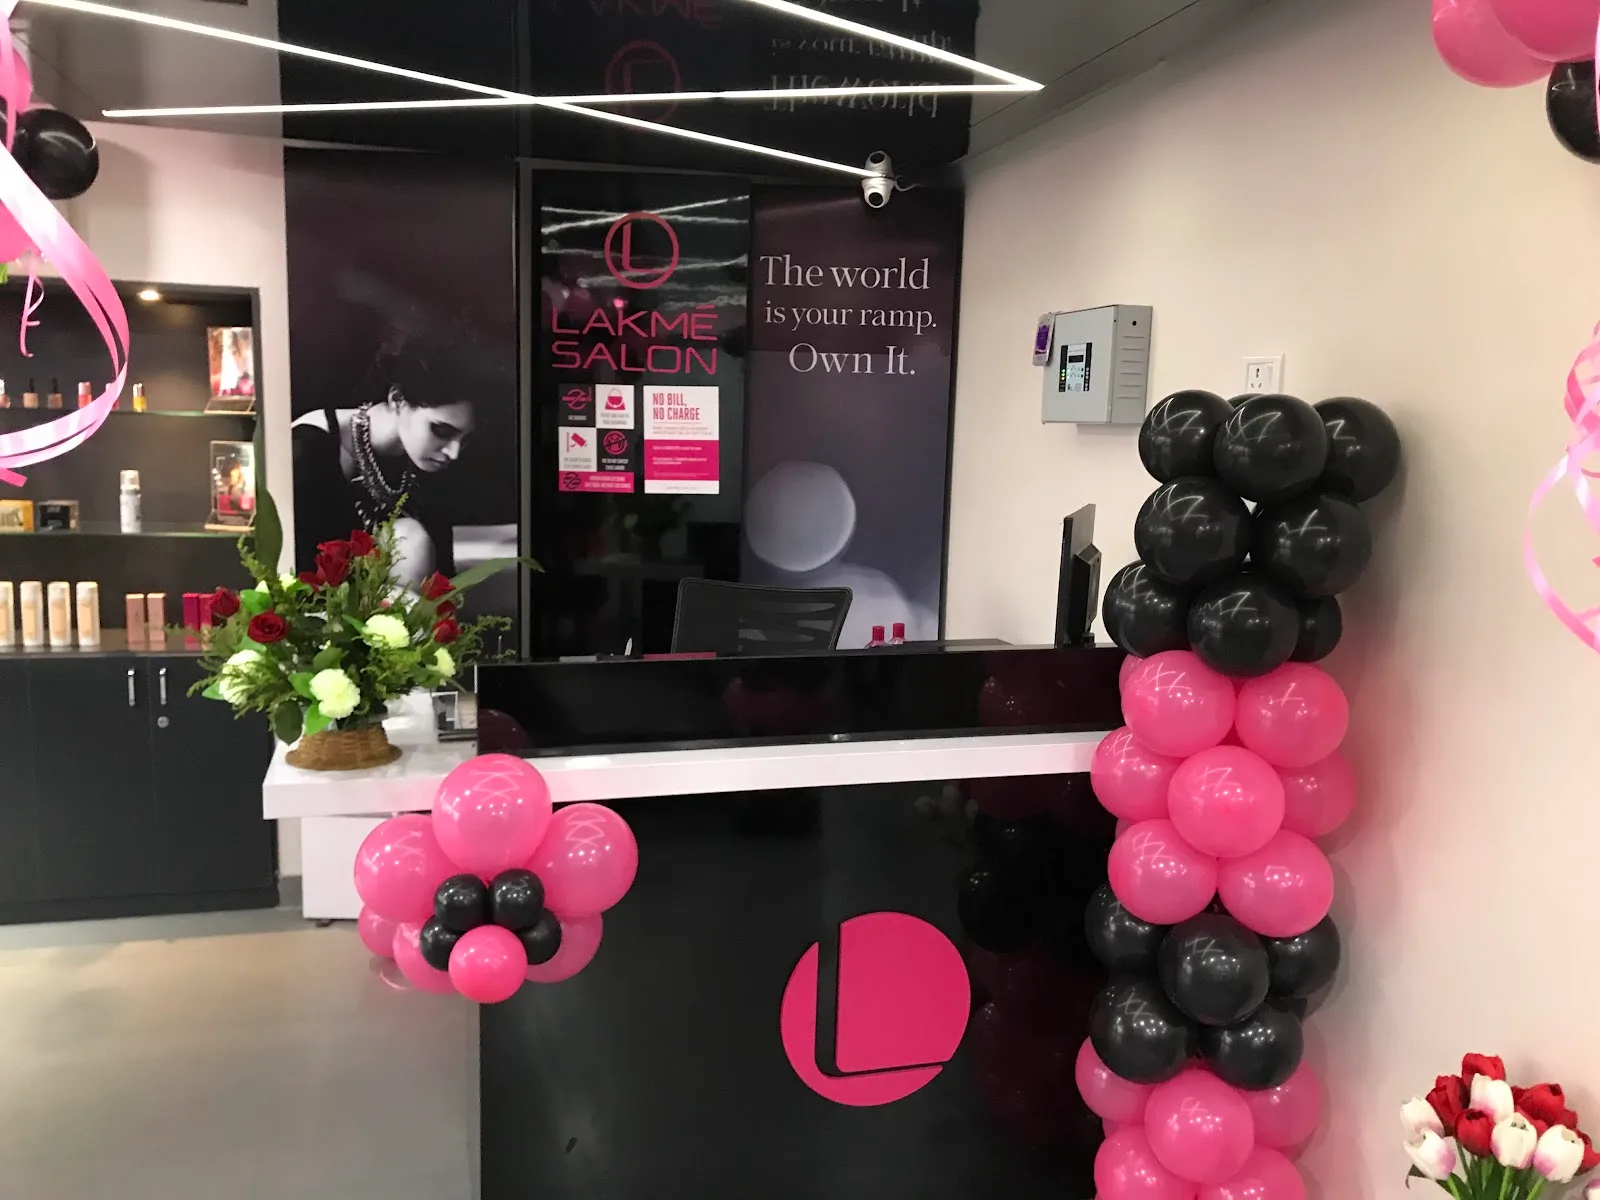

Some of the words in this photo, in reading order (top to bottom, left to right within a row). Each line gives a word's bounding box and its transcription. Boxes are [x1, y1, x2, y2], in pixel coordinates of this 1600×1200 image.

[759, 254, 824, 287] The
[829, 257, 931, 290] world
[551, 304, 719, 341] LAKMÉ
[764, 300, 786, 324] is
[791, 306, 853, 332] your
[858, 308, 938, 336] ramp.
[551, 340, 718, 375] SALON
[788, 342, 875, 374] Own
[884, 345, 916, 376] It.
[652, 392, 664, 406] NO
[667, 392, 688, 407] BILL,
[652, 407, 665, 420] NO
[667, 407, 700, 420] CHARGE
